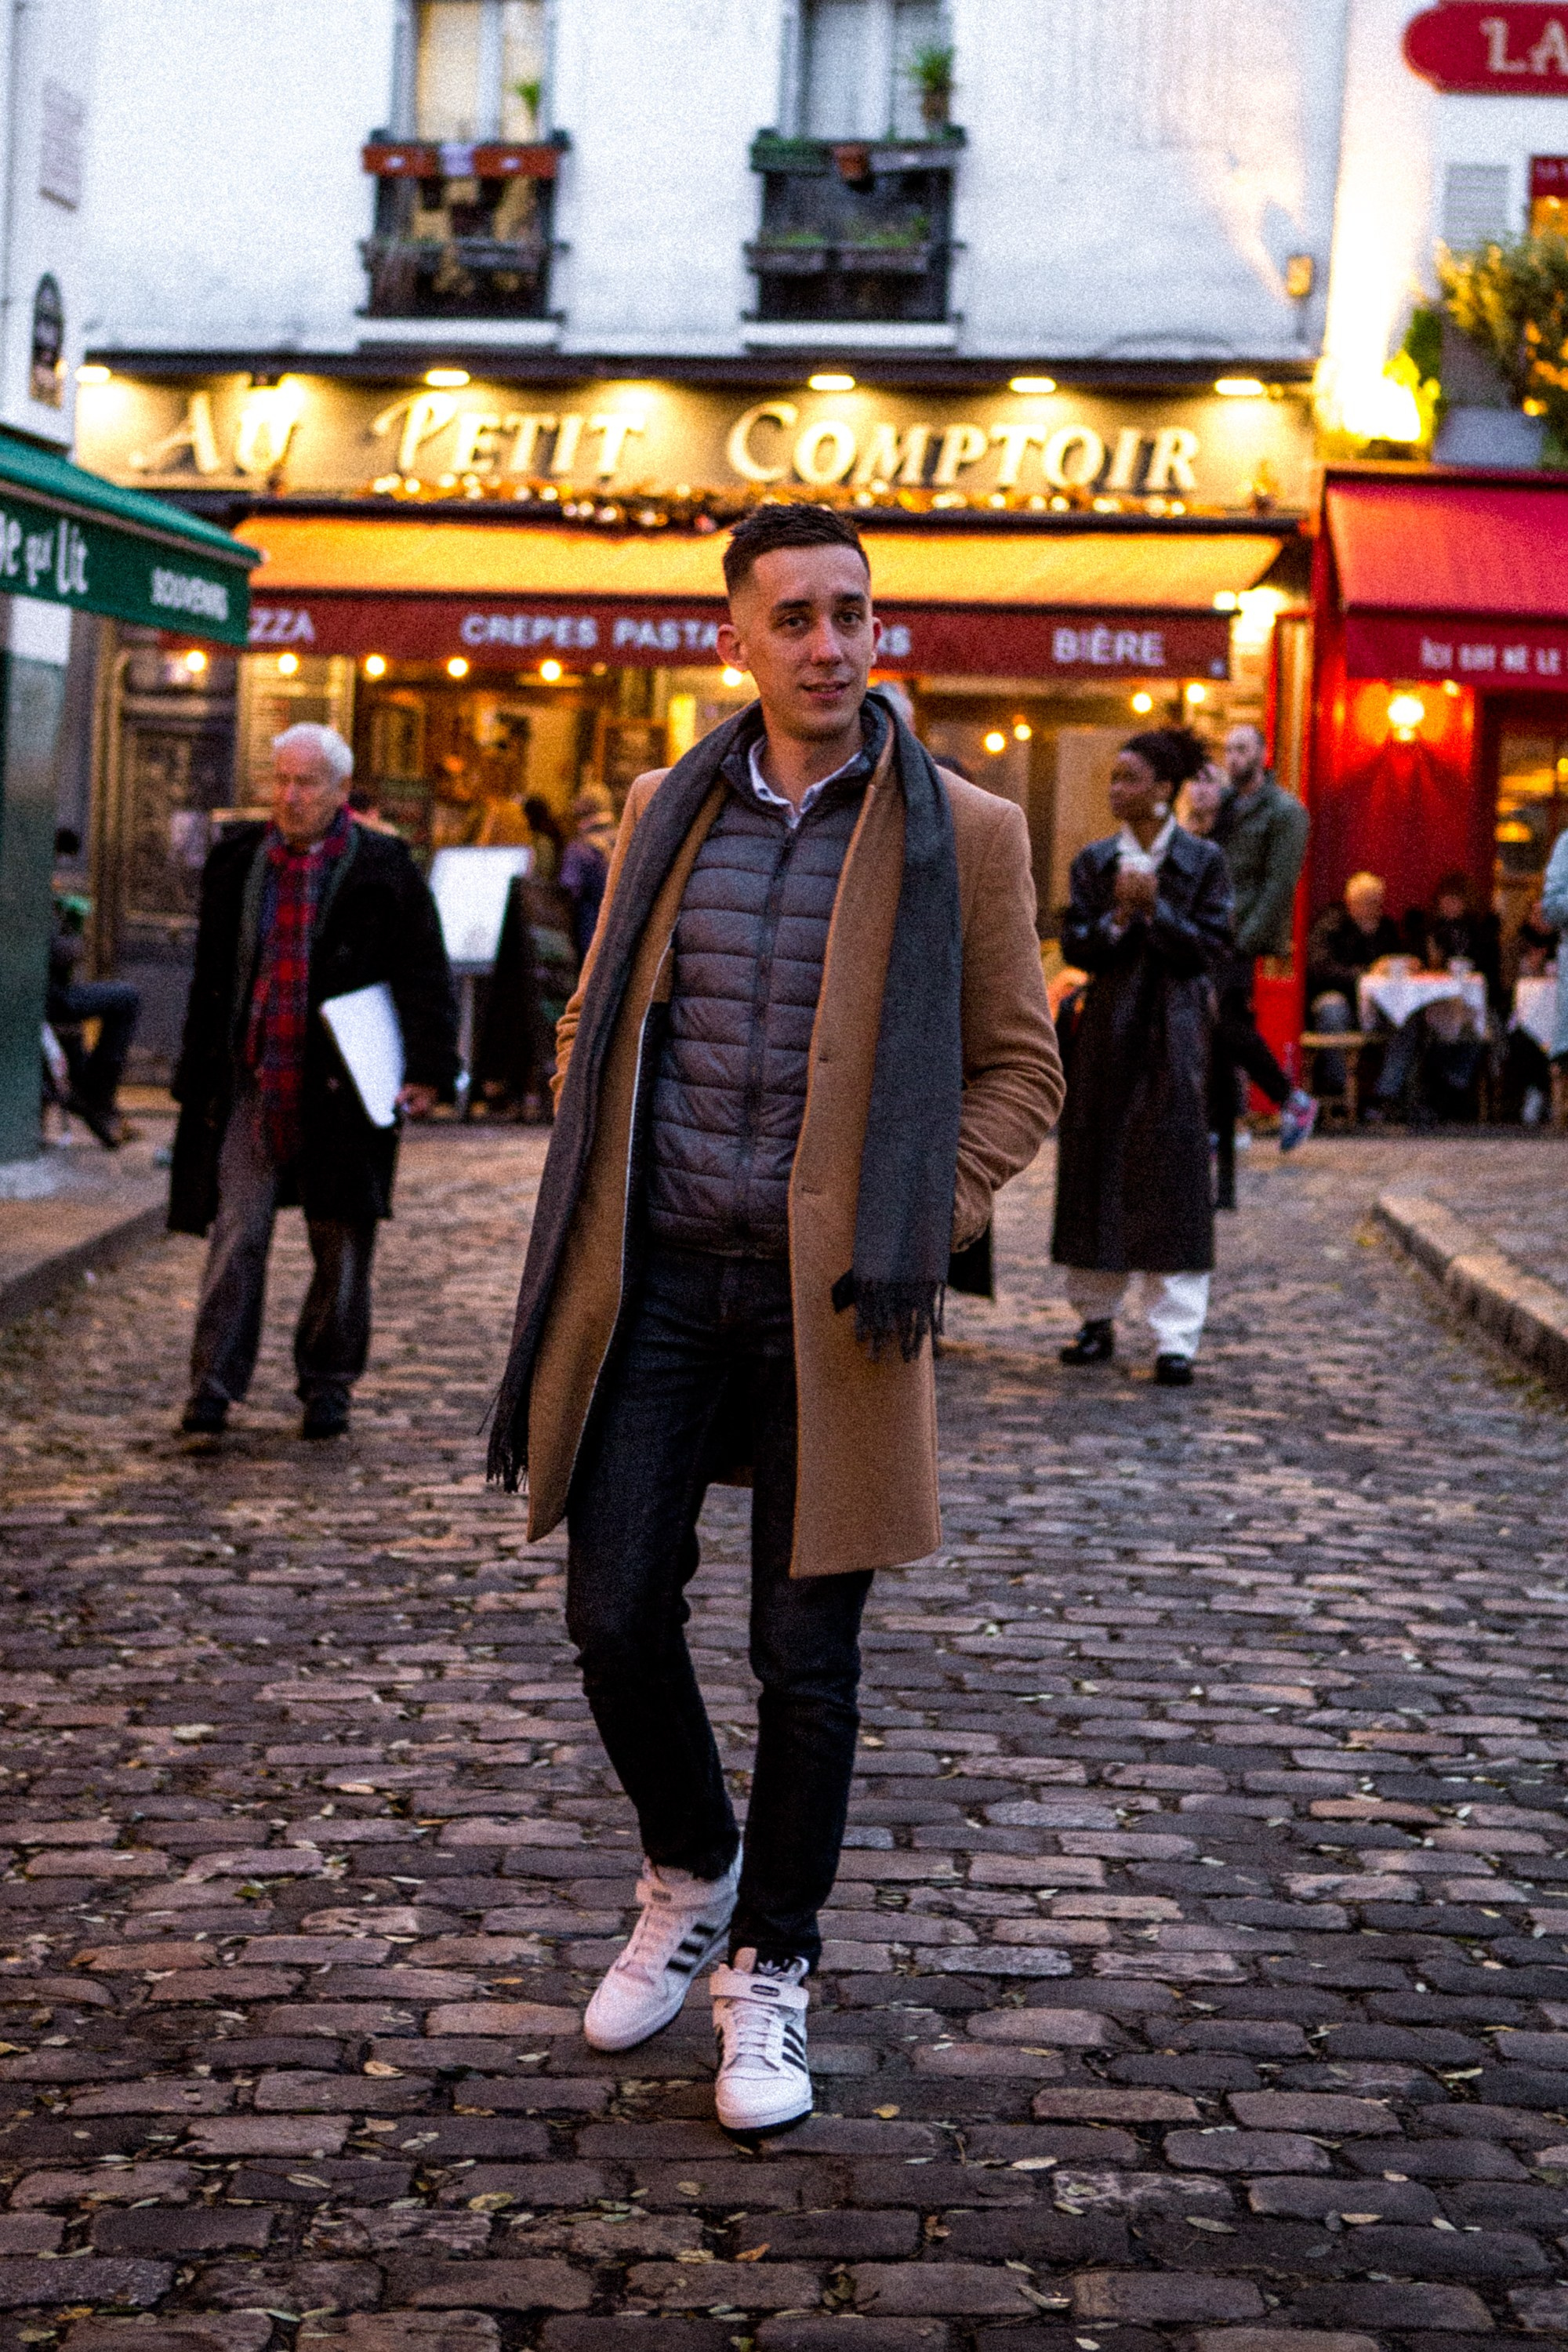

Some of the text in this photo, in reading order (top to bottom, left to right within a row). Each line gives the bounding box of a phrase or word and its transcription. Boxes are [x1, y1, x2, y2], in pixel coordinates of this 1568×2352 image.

[1479, 16, 1568, 77] LA
[372, 390, 646, 475] PETIT
[726, 400, 1200, 489] COMPTOIR
[249, 607, 315, 644] ZZA
[1052, 623, 1166, 666] BIÈRE
